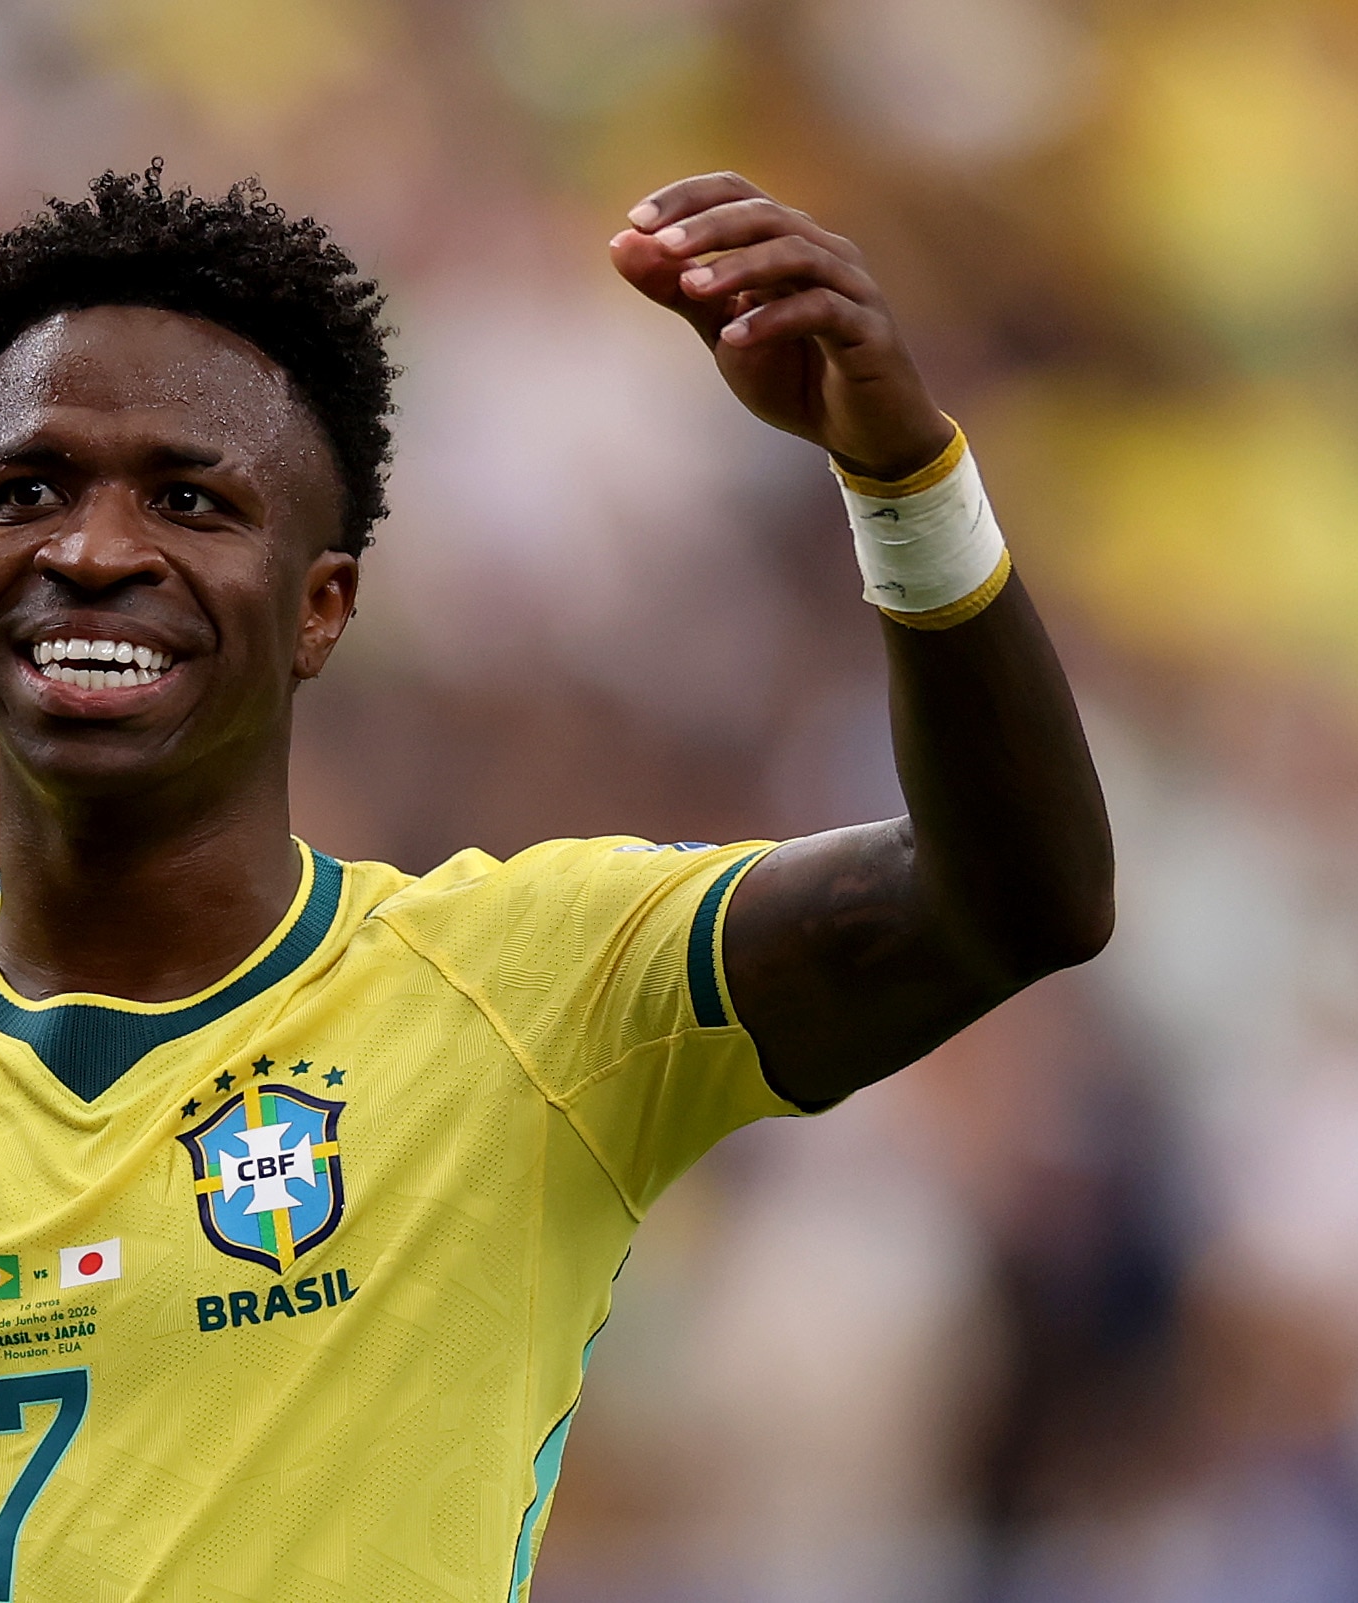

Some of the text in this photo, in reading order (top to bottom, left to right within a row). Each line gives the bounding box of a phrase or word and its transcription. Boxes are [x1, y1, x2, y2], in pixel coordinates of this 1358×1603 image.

[237, 1153, 295, 1181] CBF
[197, 1268, 360, 1332] BRASIL
[15, 1314, 47, 1327] Junho
[50, 1311, 65, 1322] de
[67, 1305, 97, 1319] 2026
[54, 1321, 96, 1340] JAPÃO
[3, 1347, 48, 1360] Houston
[58, 1341, 82, 1354] EUA
